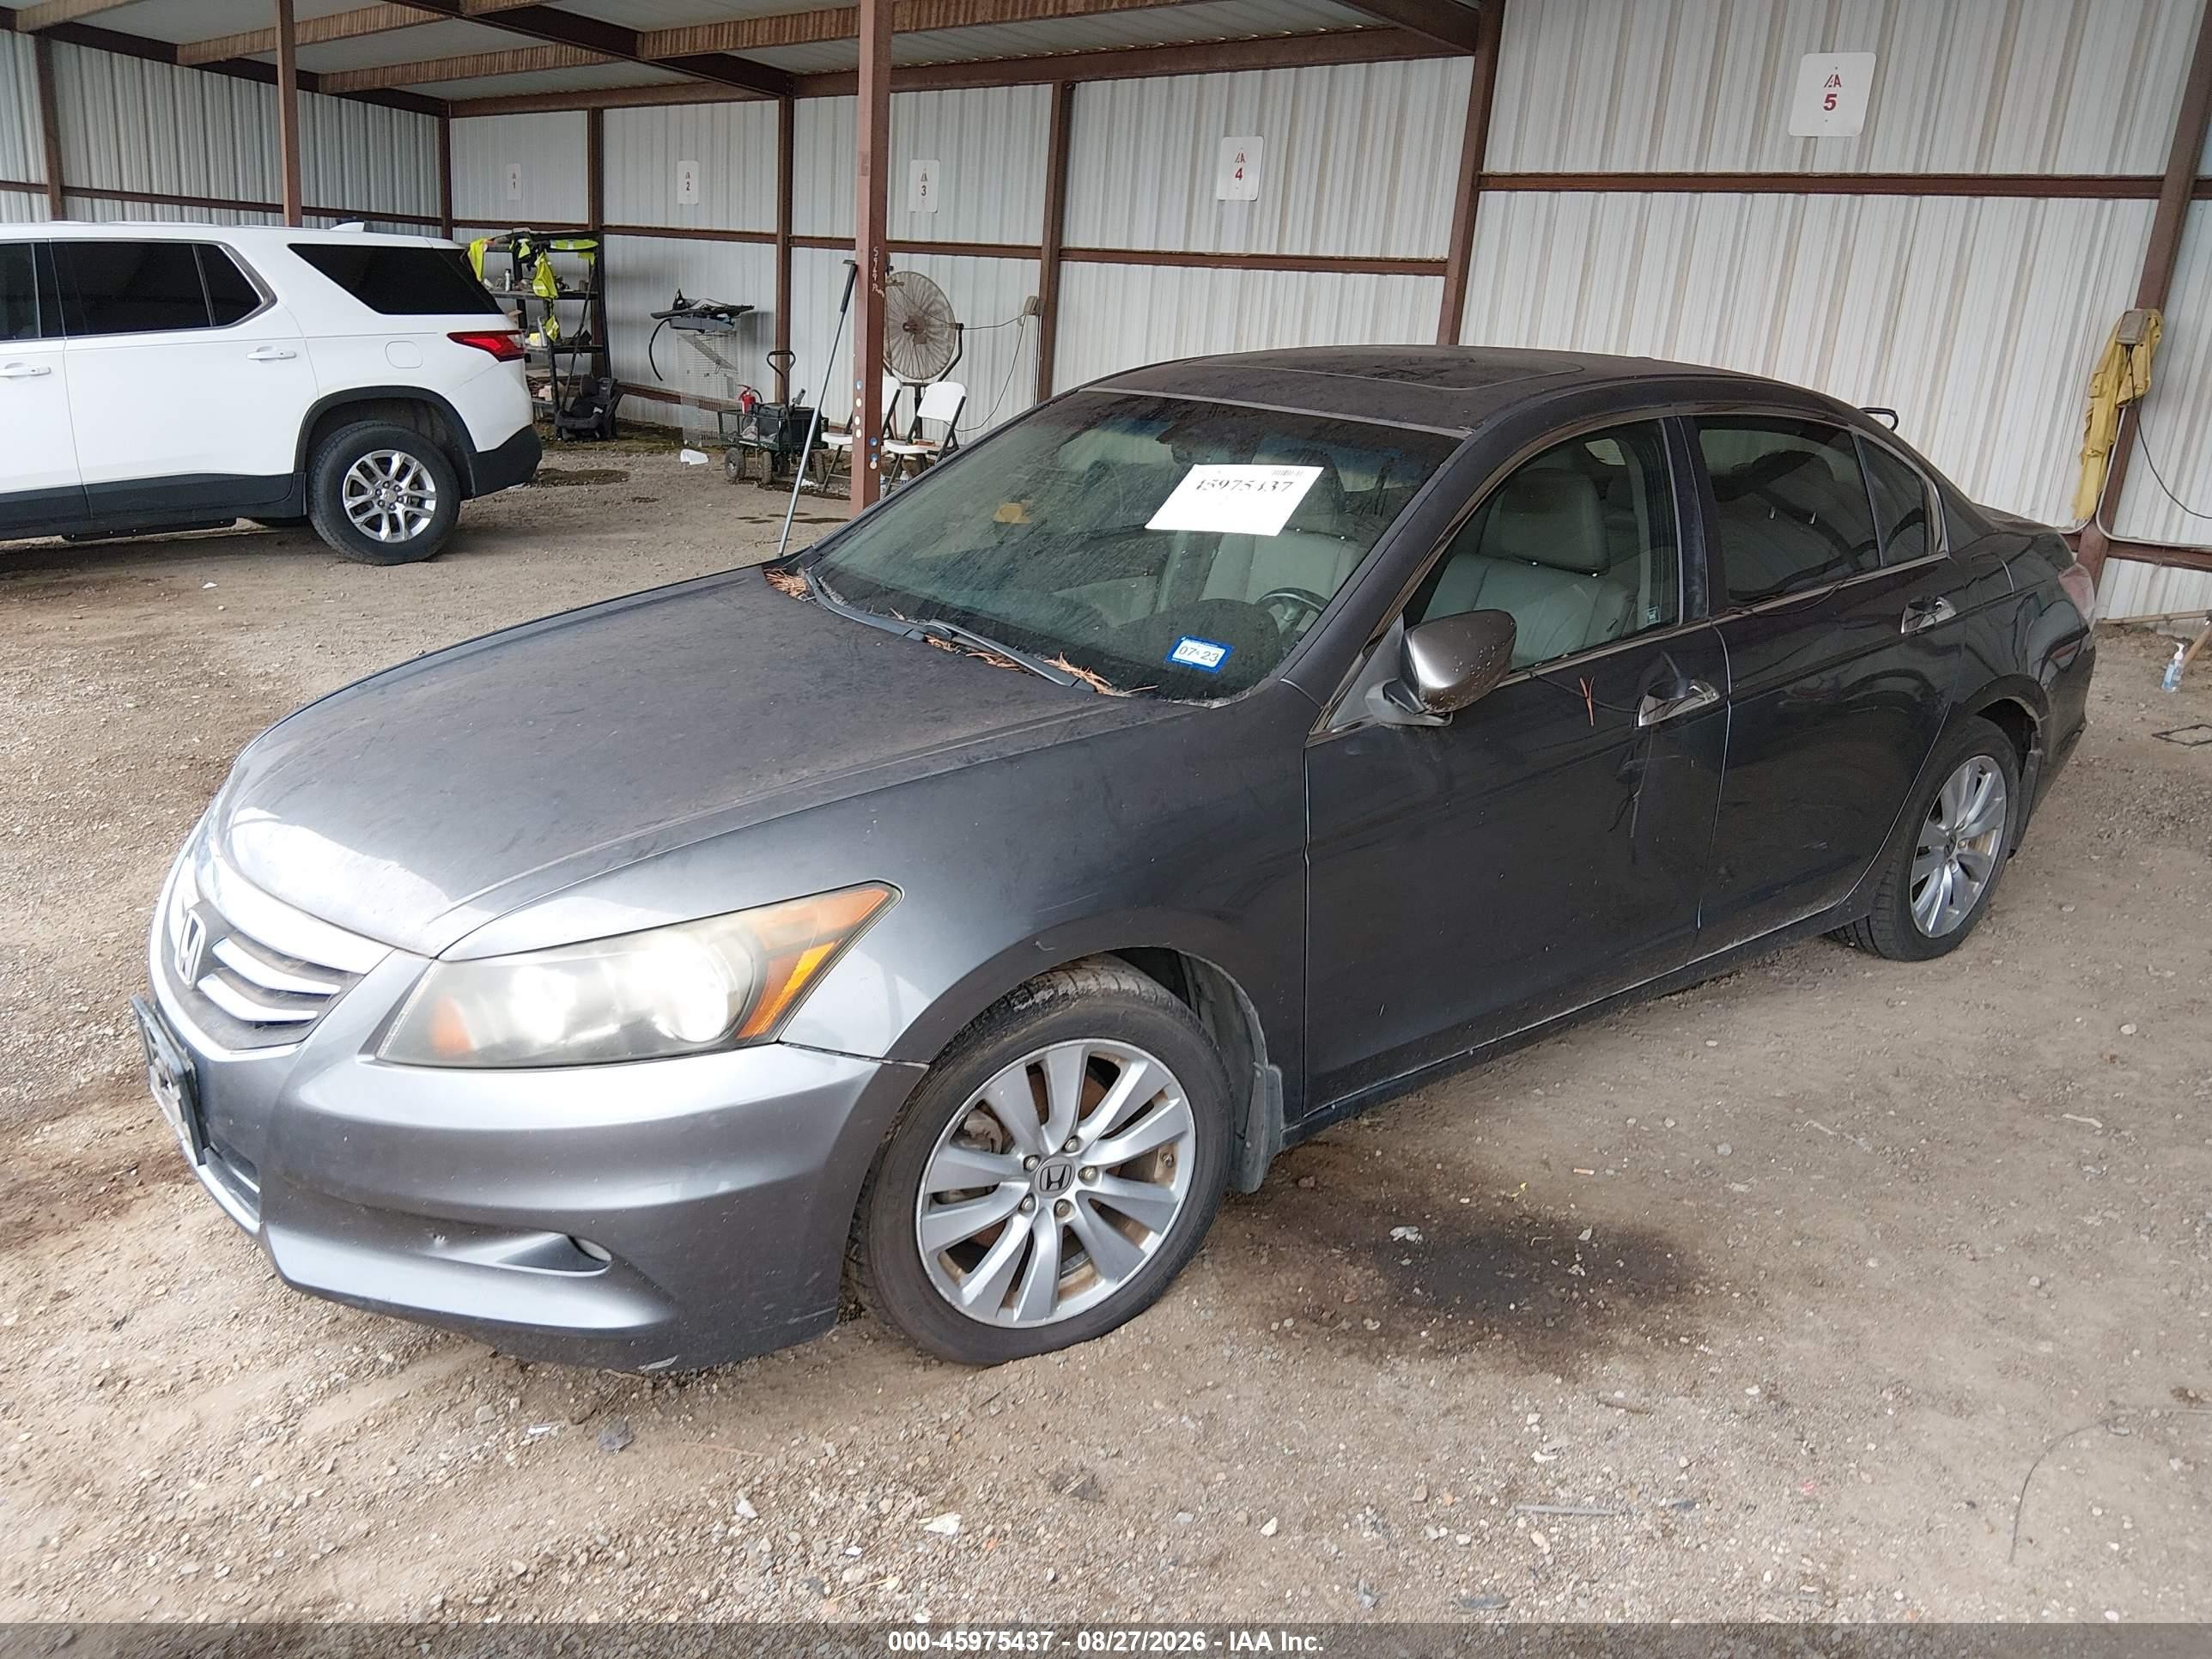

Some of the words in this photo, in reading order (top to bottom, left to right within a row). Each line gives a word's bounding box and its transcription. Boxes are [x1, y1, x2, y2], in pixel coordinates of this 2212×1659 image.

[1823, 94, 1837, 111] 5
[1235, 167, 1243, 181] 4
[921, 185, 927, 197] 3
